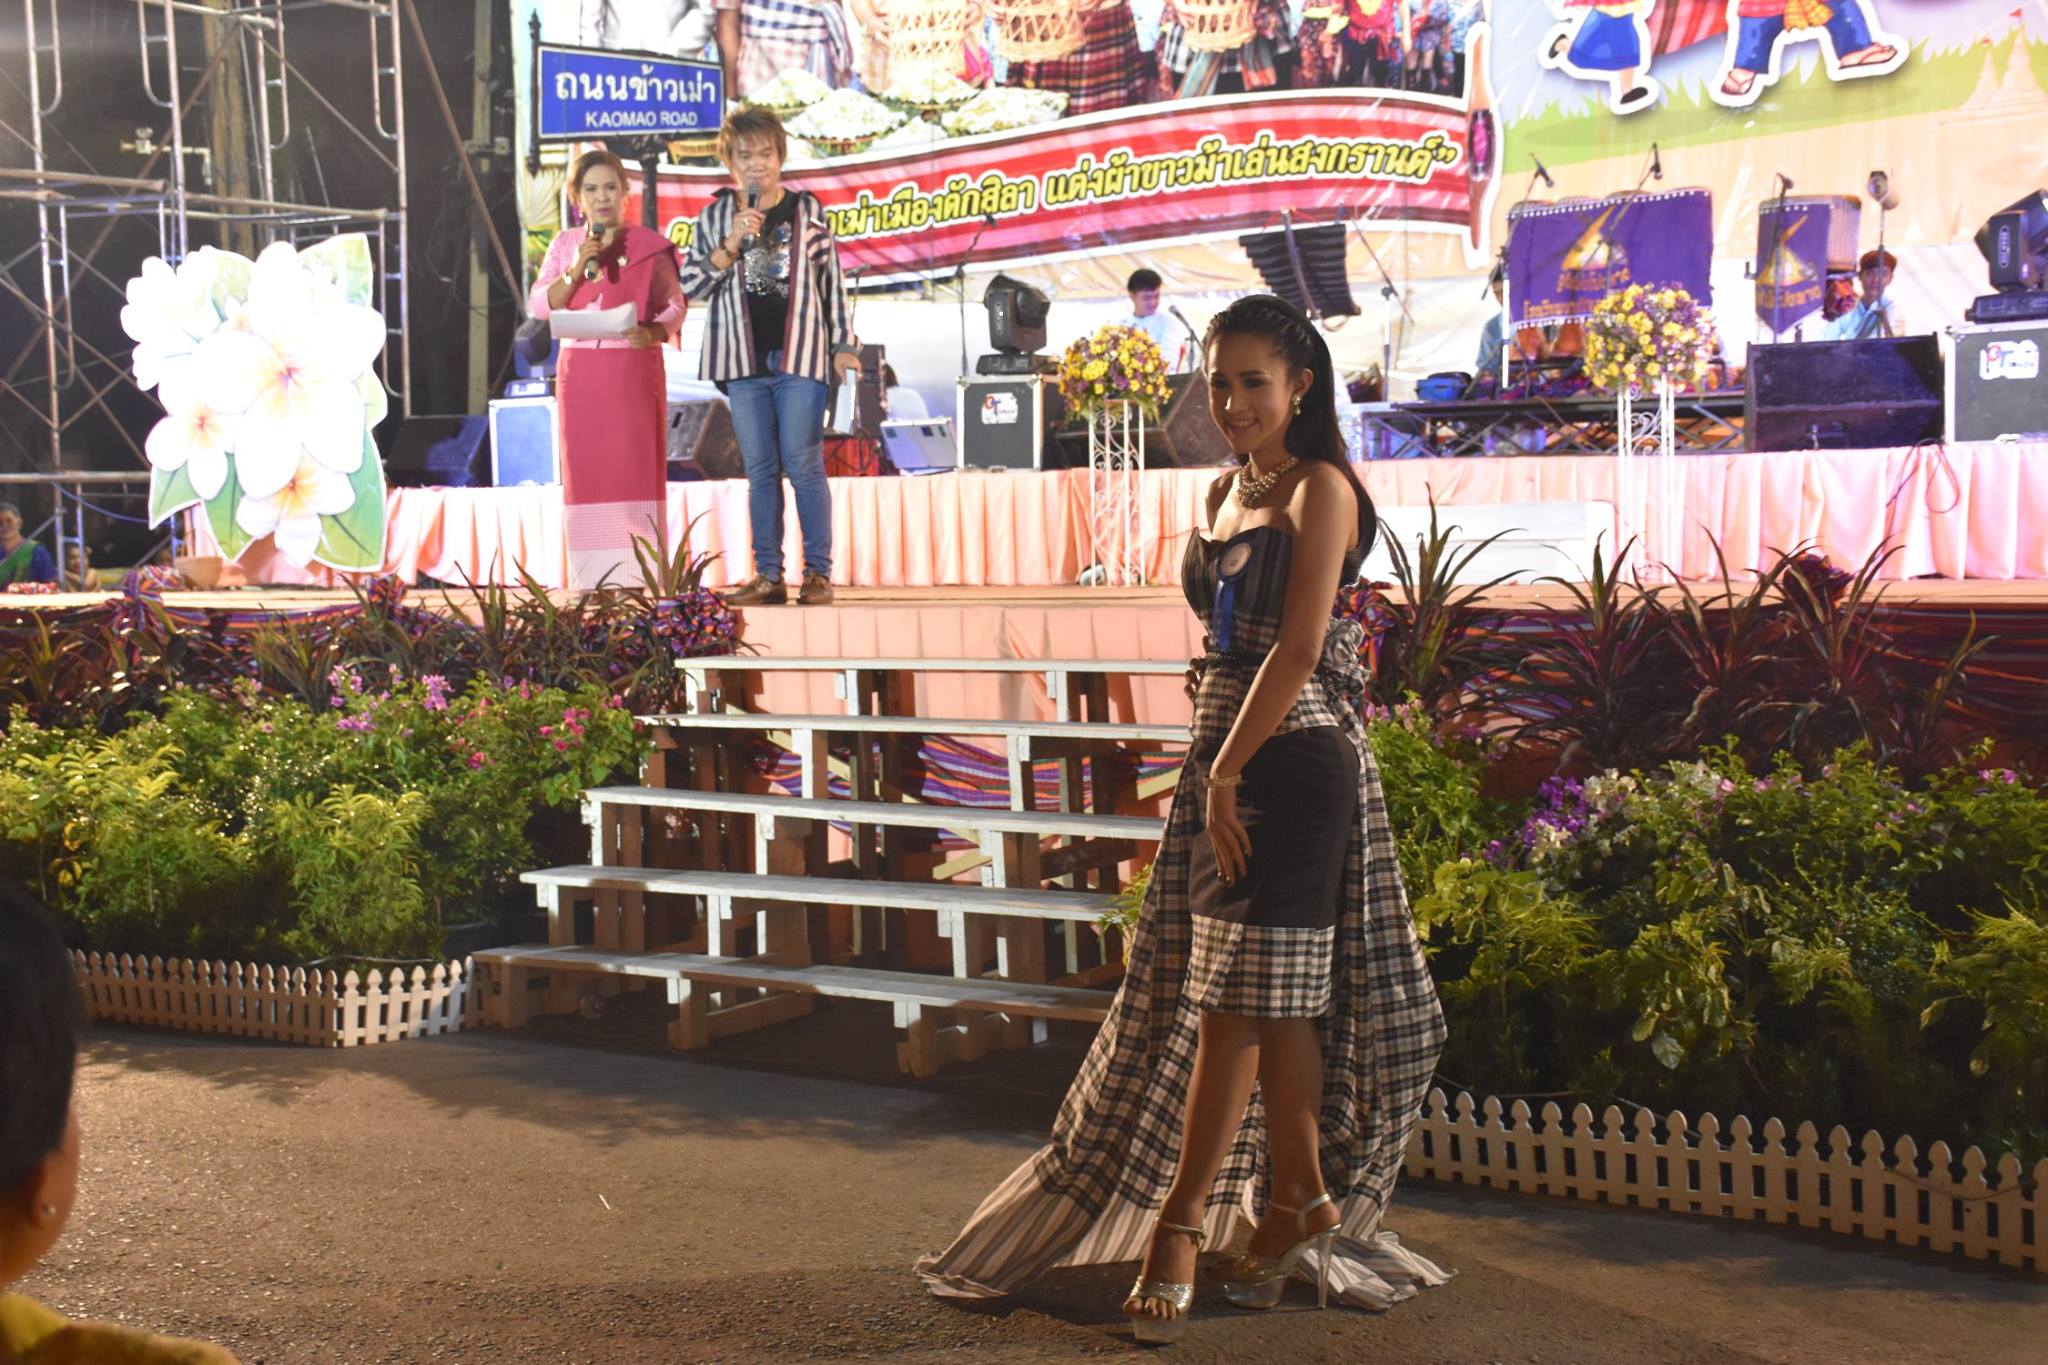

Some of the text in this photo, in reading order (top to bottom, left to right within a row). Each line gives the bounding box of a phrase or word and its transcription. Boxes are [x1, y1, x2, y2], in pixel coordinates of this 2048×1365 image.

[555, 63, 716, 104] ถนนข้าวเม่า
[585, 110, 698, 128] KAOMAO ROAD
